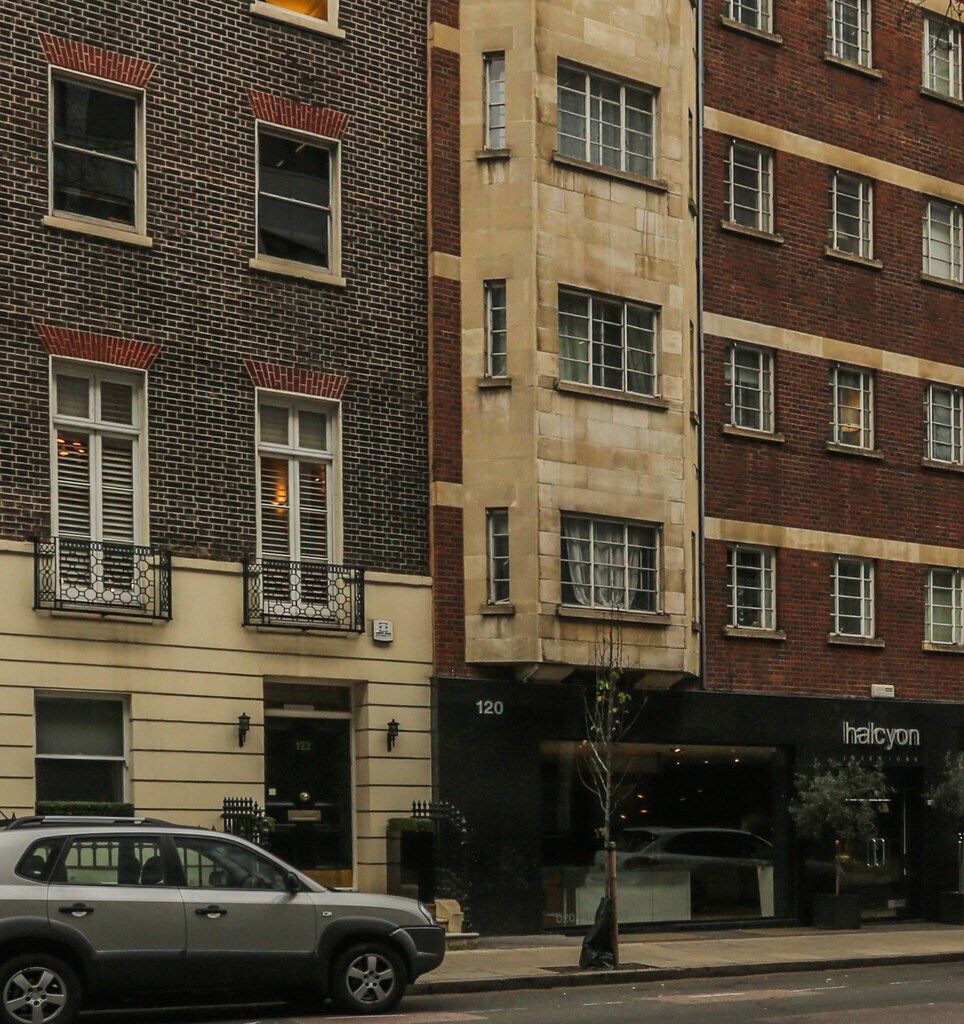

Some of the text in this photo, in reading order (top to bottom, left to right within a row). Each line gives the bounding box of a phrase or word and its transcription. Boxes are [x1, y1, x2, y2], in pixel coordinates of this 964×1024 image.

[475, 700, 504, 715] 120
[843, 721, 920, 750] halcyon
[295, 741, 311, 751] 122
